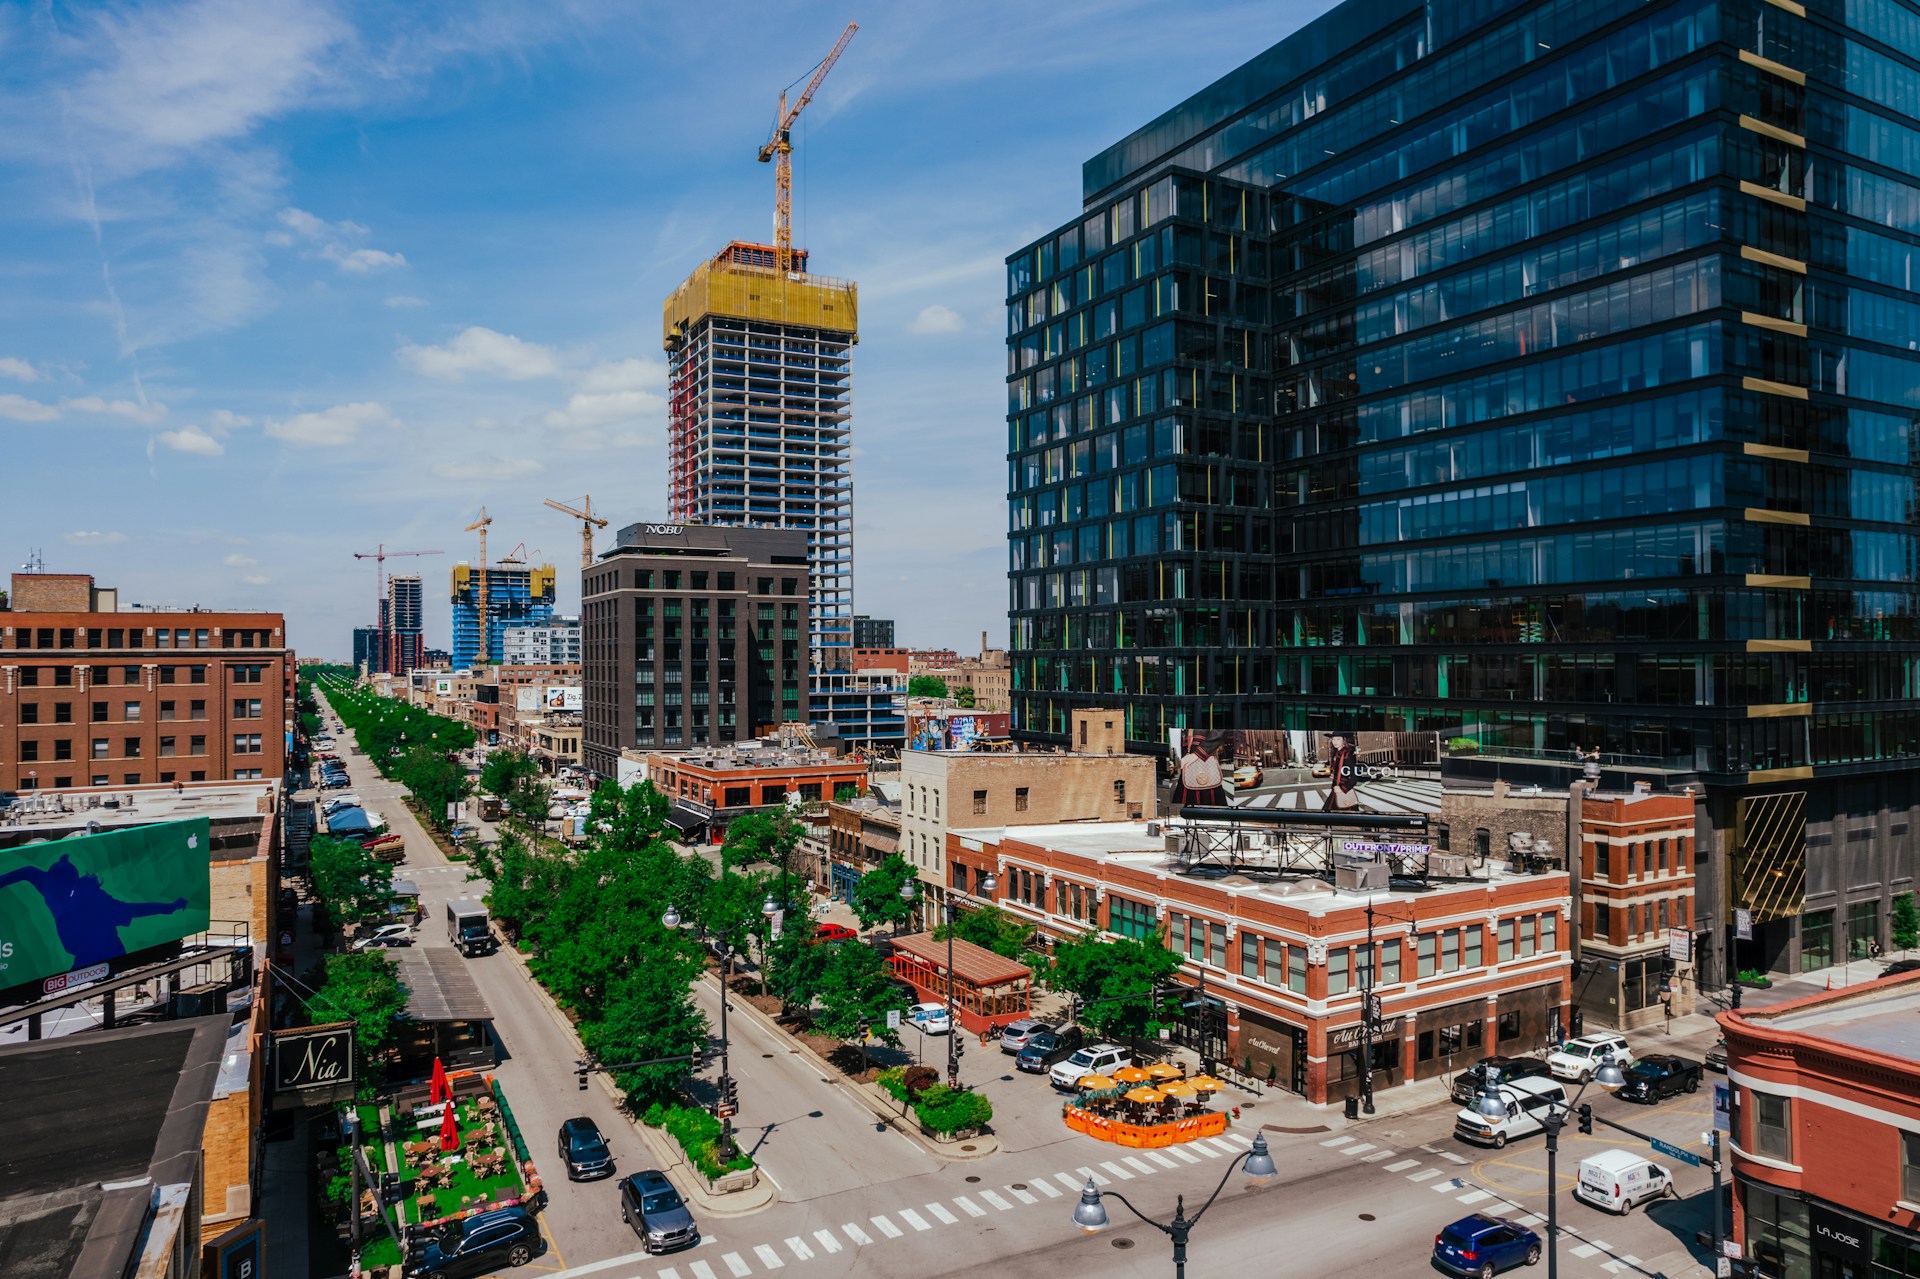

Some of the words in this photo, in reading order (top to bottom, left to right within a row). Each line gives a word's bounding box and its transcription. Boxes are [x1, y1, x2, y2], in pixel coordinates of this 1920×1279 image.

[645, 524, 684, 535] NOBU
[1340, 765, 1399, 778] GUCCI
[47, 975, 65, 991] BIG
[67, 966, 107, 983] OUTDOOR
[284, 1036, 342, 1084] Nia
[1659, 1141, 1689, 1158] RANDOLPH
[1816, 1224, 1830, 1237] LA
[1830, 1231, 1860, 1248] JOSIE
